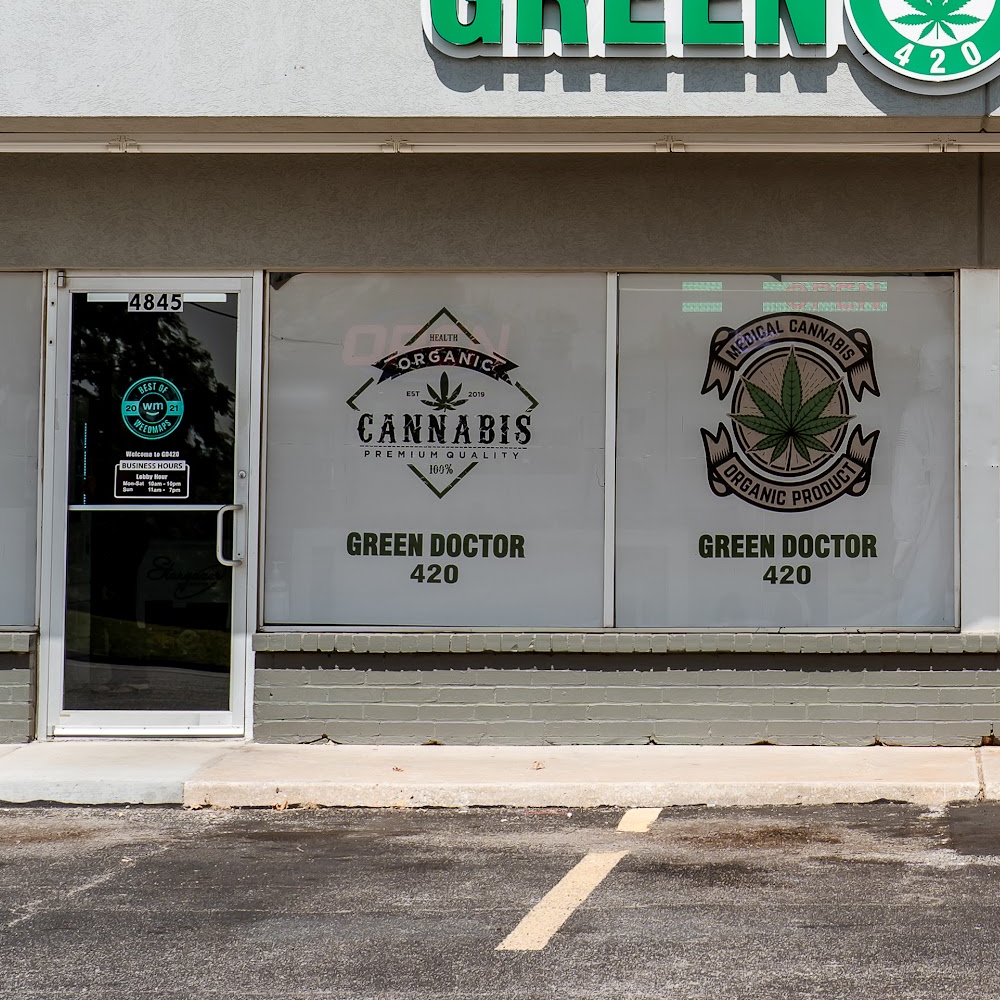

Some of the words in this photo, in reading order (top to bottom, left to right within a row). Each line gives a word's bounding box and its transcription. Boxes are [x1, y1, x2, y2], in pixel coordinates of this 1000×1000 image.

[894, 40, 982, 74] 420
[129, 293, 182, 310] 4845
[429, 333, 459, 342] HEALTH
[725, 319, 784, 361] MEDICAL
[789, 319, 856, 361] CANNABIS
[398, 350, 493, 371] ORGANIC
[138, 383, 157, 394] BEST
[158, 384, 168, 393] OF
[125, 404, 137, 412] 20
[142, 402, 163, 410] wm
[169, 404, 179, 412] 21
[133, 419, 172, 434] WEEDMAPS
[357, 413, 532, 445] CANNABIS
[364, 450, 438, 459] PREMIUM
[446, 451, 520, 460] QUALITY
[429, 464, 454, 475] 100%
[723, 464, 788, 506] ORGANIC
[792, 461, 857, 506] PRODUCT
[346, 532, 424, 557] GREEN
[430, 533, 526, 559] DOCTOR
[698, 534, 775, 559] GREEN
[782, 534, 878, 559] DOCTOR
[410, 564, 459, 584] 420
[762, 565, 811, 585] 420
